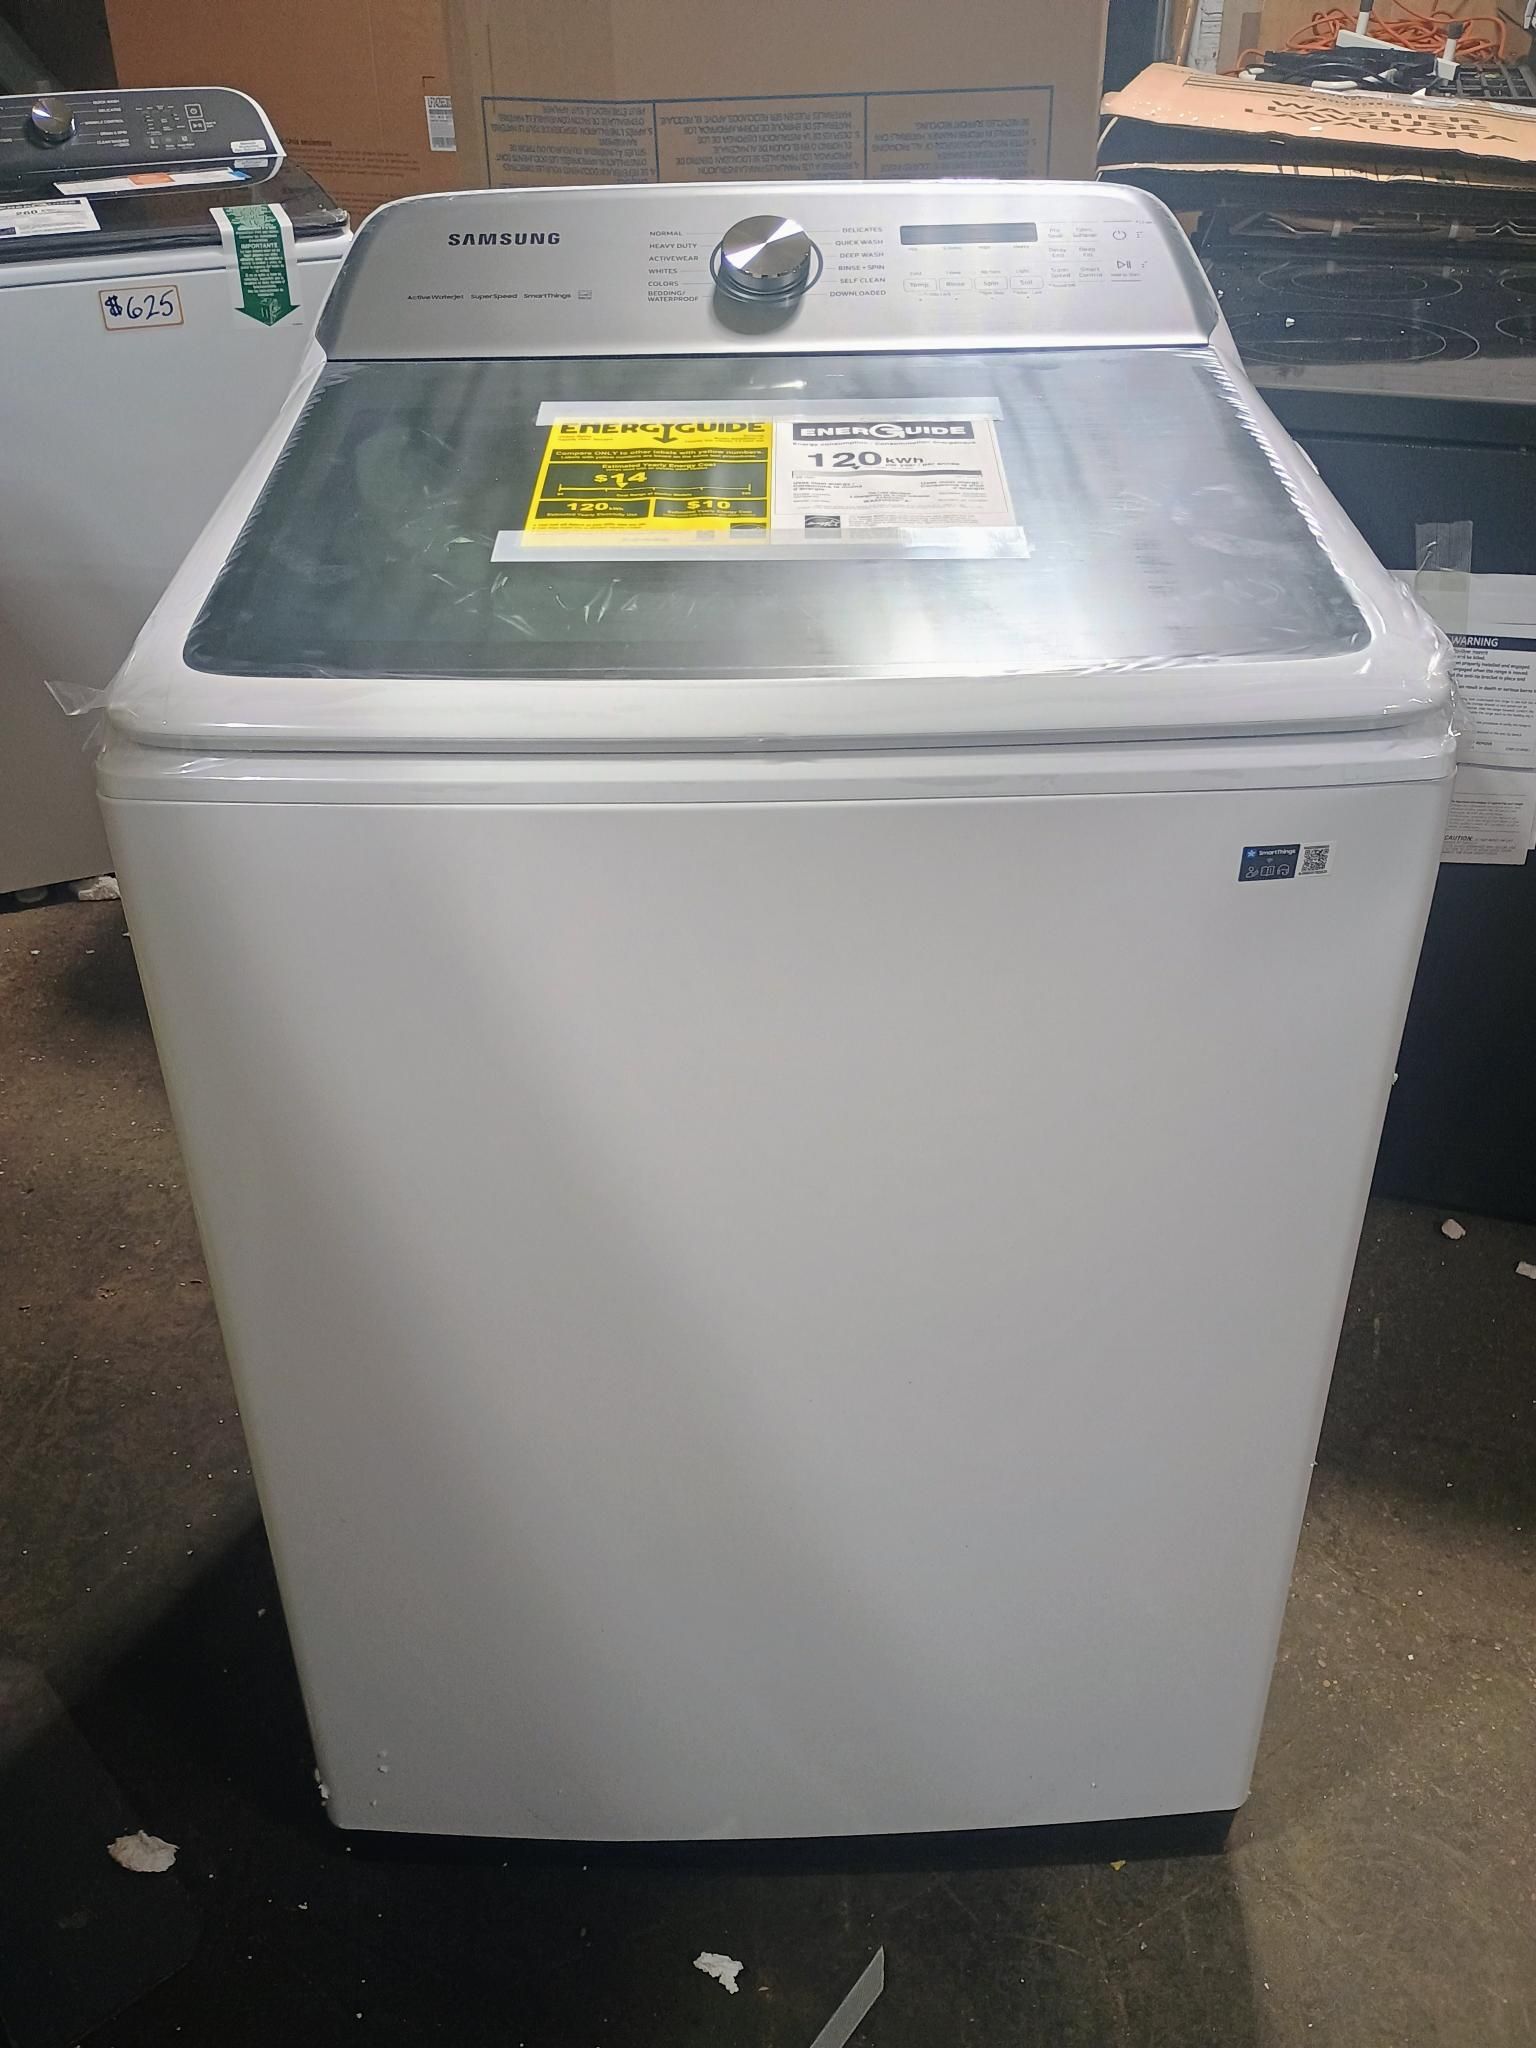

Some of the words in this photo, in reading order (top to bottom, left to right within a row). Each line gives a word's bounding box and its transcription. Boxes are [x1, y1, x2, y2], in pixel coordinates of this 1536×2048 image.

[1271, 99, 1480, 124] WASHER
[1244, 108, 1518, 142] LAVADORA
[1267, 106, 1490, 132] LAVEUSE
[448, 232, 561, 246] SAMSUNG
[104, 289, 174, 320] $625
[800, 424, 966, 438] ENERGUIDE
[808, 451, 882, 467] 120
[594, 472, 648, 483] $14
[567, 502, 609, 511] 120
[687, 500, 731, 509] $10
[1452, 636, 1499, 647] WARNING
